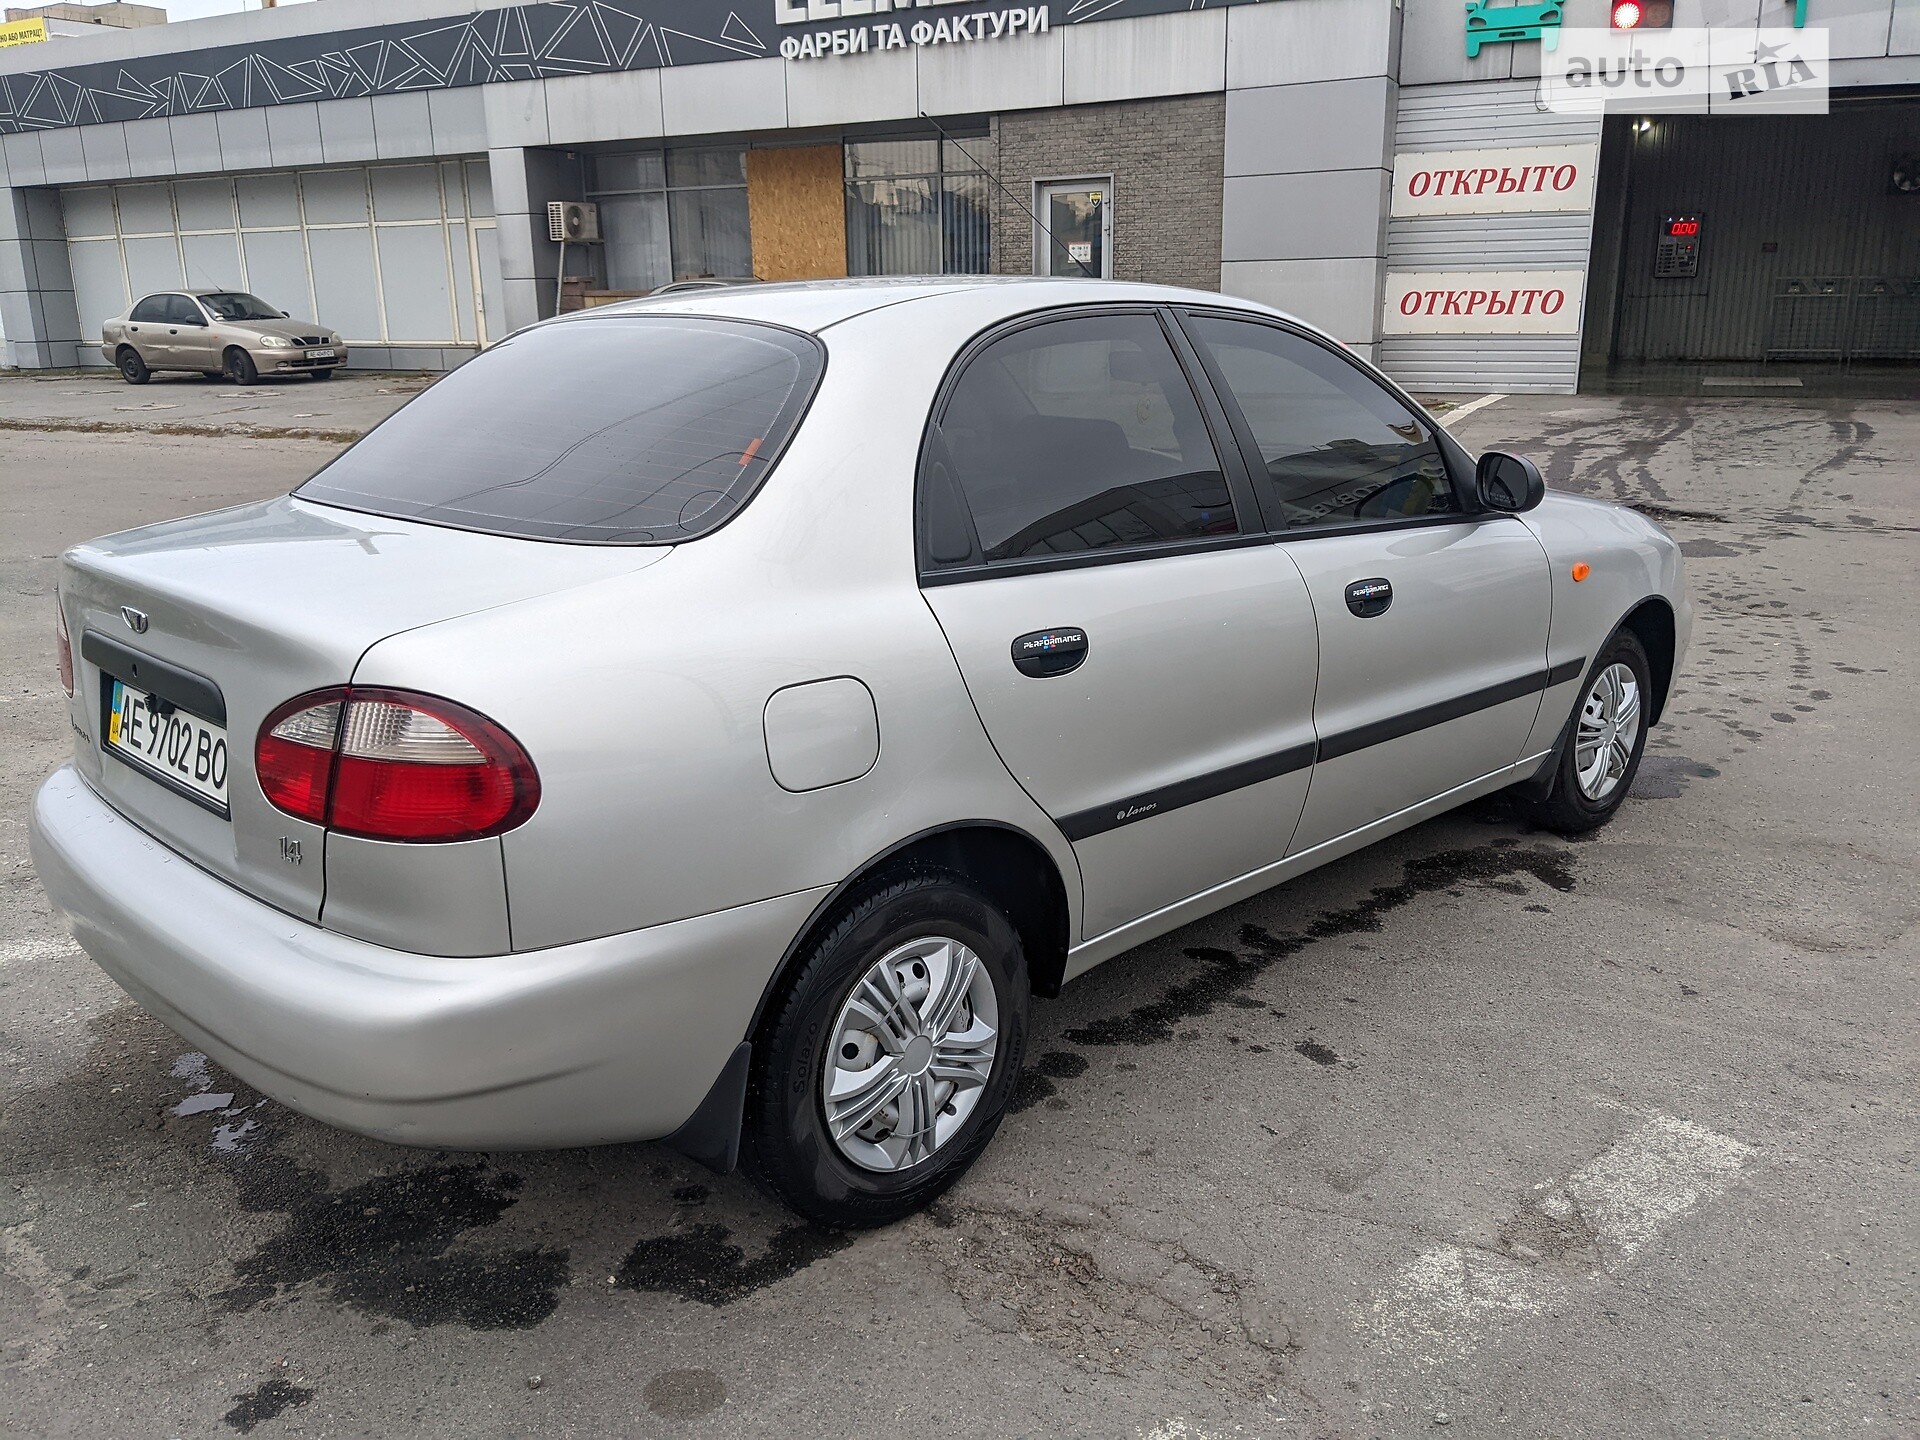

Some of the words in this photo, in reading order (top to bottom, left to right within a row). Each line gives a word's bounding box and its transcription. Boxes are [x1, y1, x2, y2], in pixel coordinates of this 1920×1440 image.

[779, 26, 869, 61] ФАРБИ
[872, 23, 908, 51] ТА
[910, 5, 1050, 46] ФАКТУРИ
[1408, 164, 1577, 198] ОТКРЫТО
[1400, 289, 1565, 316] ОТКРЫТО
[1023, 634, 1082, 650] PERFORMANCE
[119, 695, 145, 750] AE
[146, 711, 193, 774] 9702
[194, 728, 228, 790] BO
